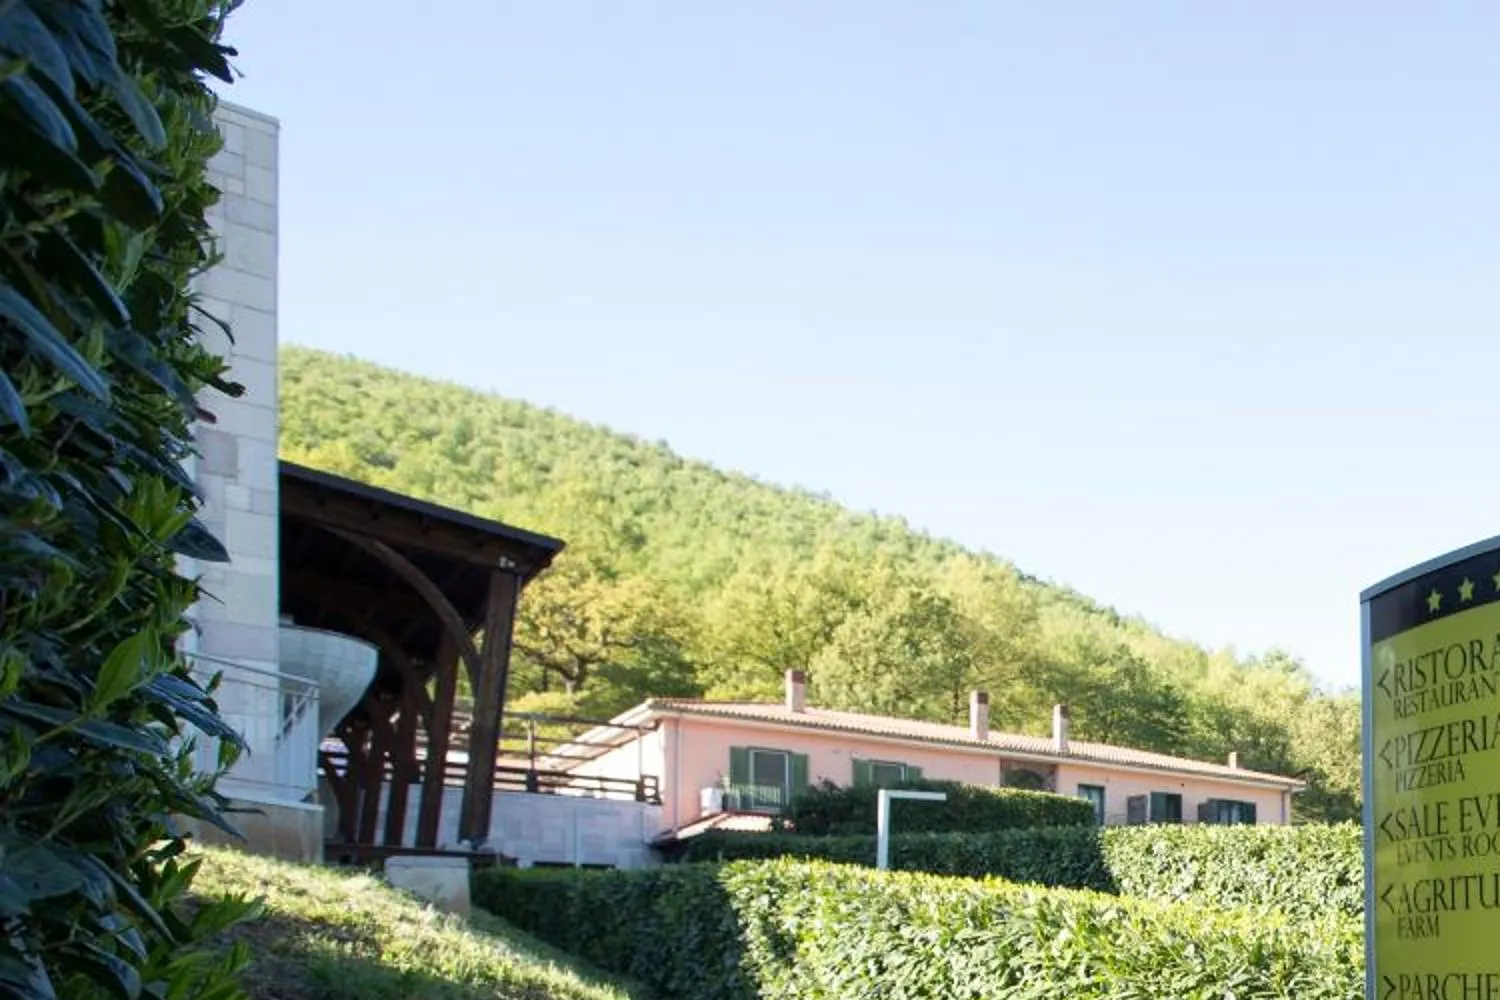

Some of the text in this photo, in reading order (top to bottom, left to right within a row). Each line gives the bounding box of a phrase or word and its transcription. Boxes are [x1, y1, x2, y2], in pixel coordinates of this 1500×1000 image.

[1395, 758, 1466, 793] PIZZERIA
[1393, 801, 1449, 843] SALE
[1397, 834, 1456, 867] EVENTS
[1397, 914, 1440, 939] FARM
